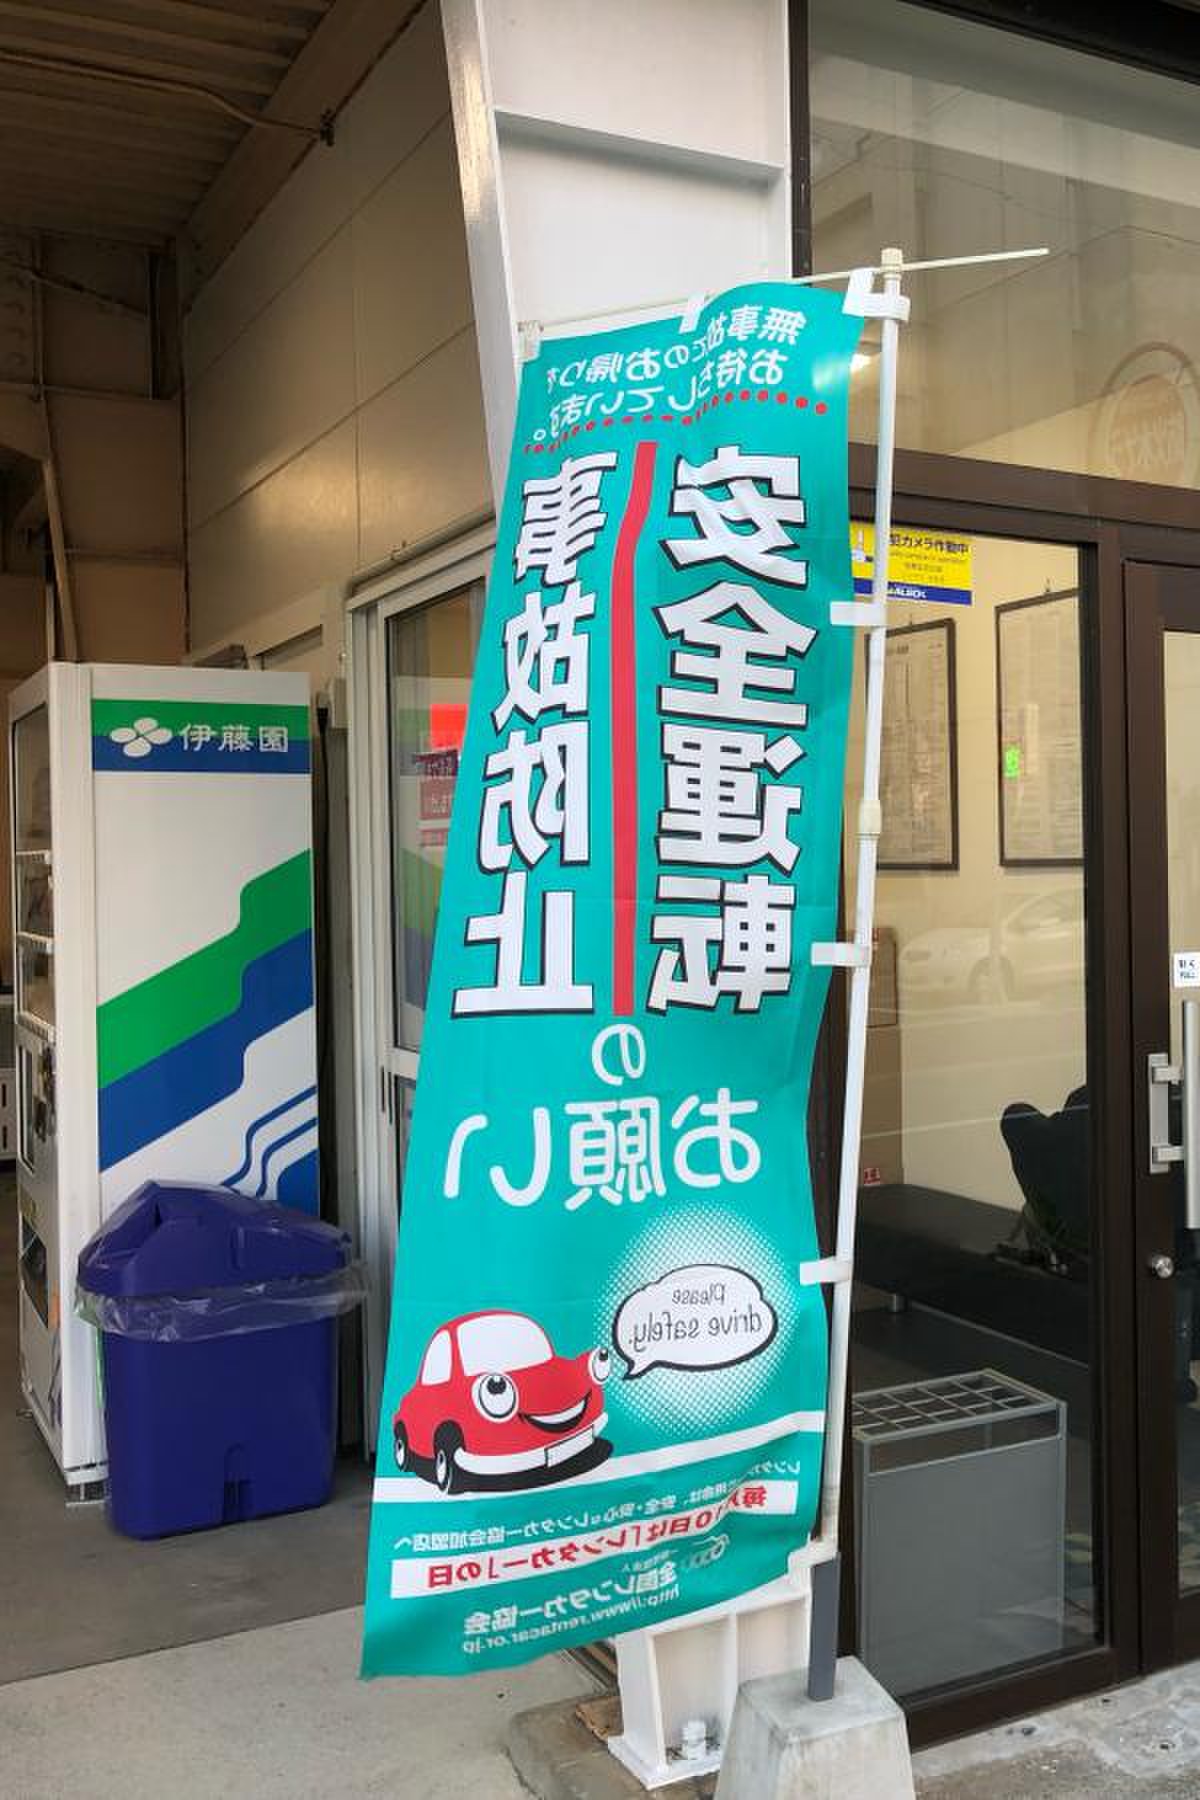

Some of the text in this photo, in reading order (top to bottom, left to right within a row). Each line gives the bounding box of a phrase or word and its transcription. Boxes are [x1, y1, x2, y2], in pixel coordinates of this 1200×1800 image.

[889, 532, 968, 554] 犯カメラ作動中
[179, 723, 289, 752] 伊藤園
